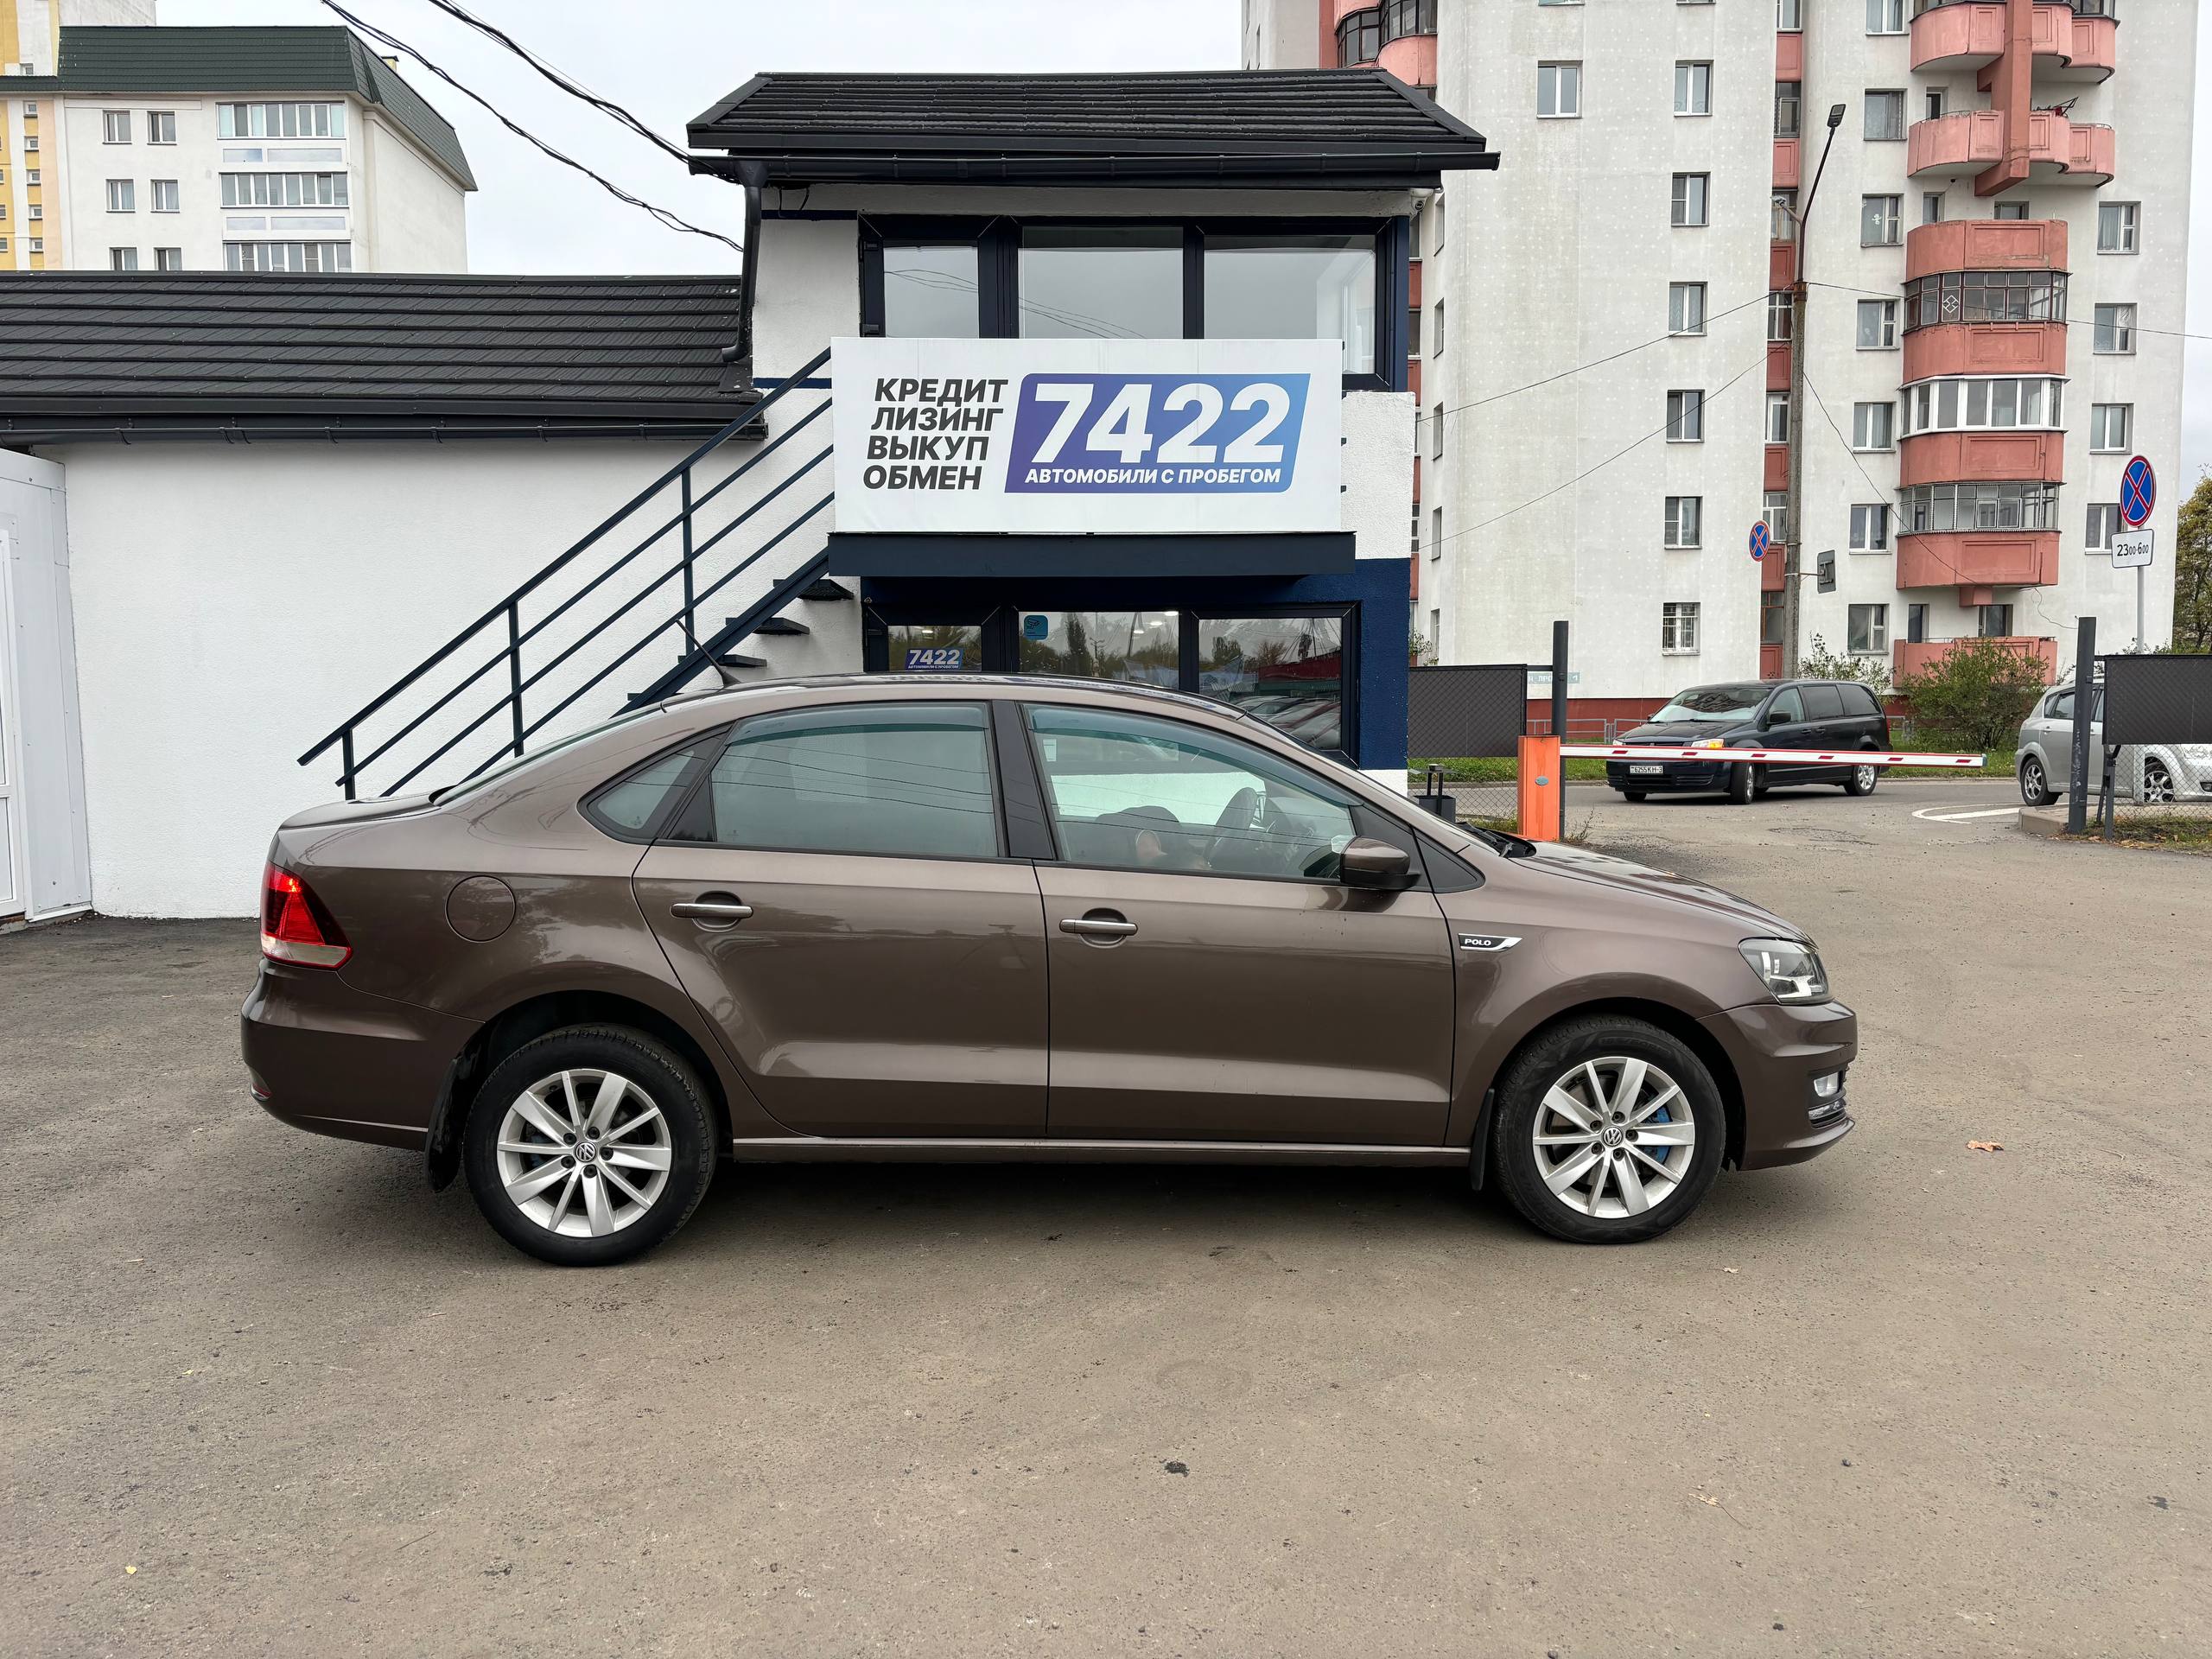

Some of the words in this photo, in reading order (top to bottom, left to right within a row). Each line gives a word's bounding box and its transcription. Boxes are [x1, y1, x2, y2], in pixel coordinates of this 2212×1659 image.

[874, 378, 1008, 407] КРЕДИТ
[871, 407, 1004, 431] ЛИЗИНГ
[1032, 383, 1290, 463] 7422
[867, 435, 989, 461] ВЫКУП
[863, 465, 982, 490] ОБМЕН
[1025, 468, 1157, 483] АВТОМОБИЛИ
[1161, 469, 1174, 483] С
[1179, 468, 1281, 483] ПРОБЕГОМ
[909, 649, 960, 664] 7422
